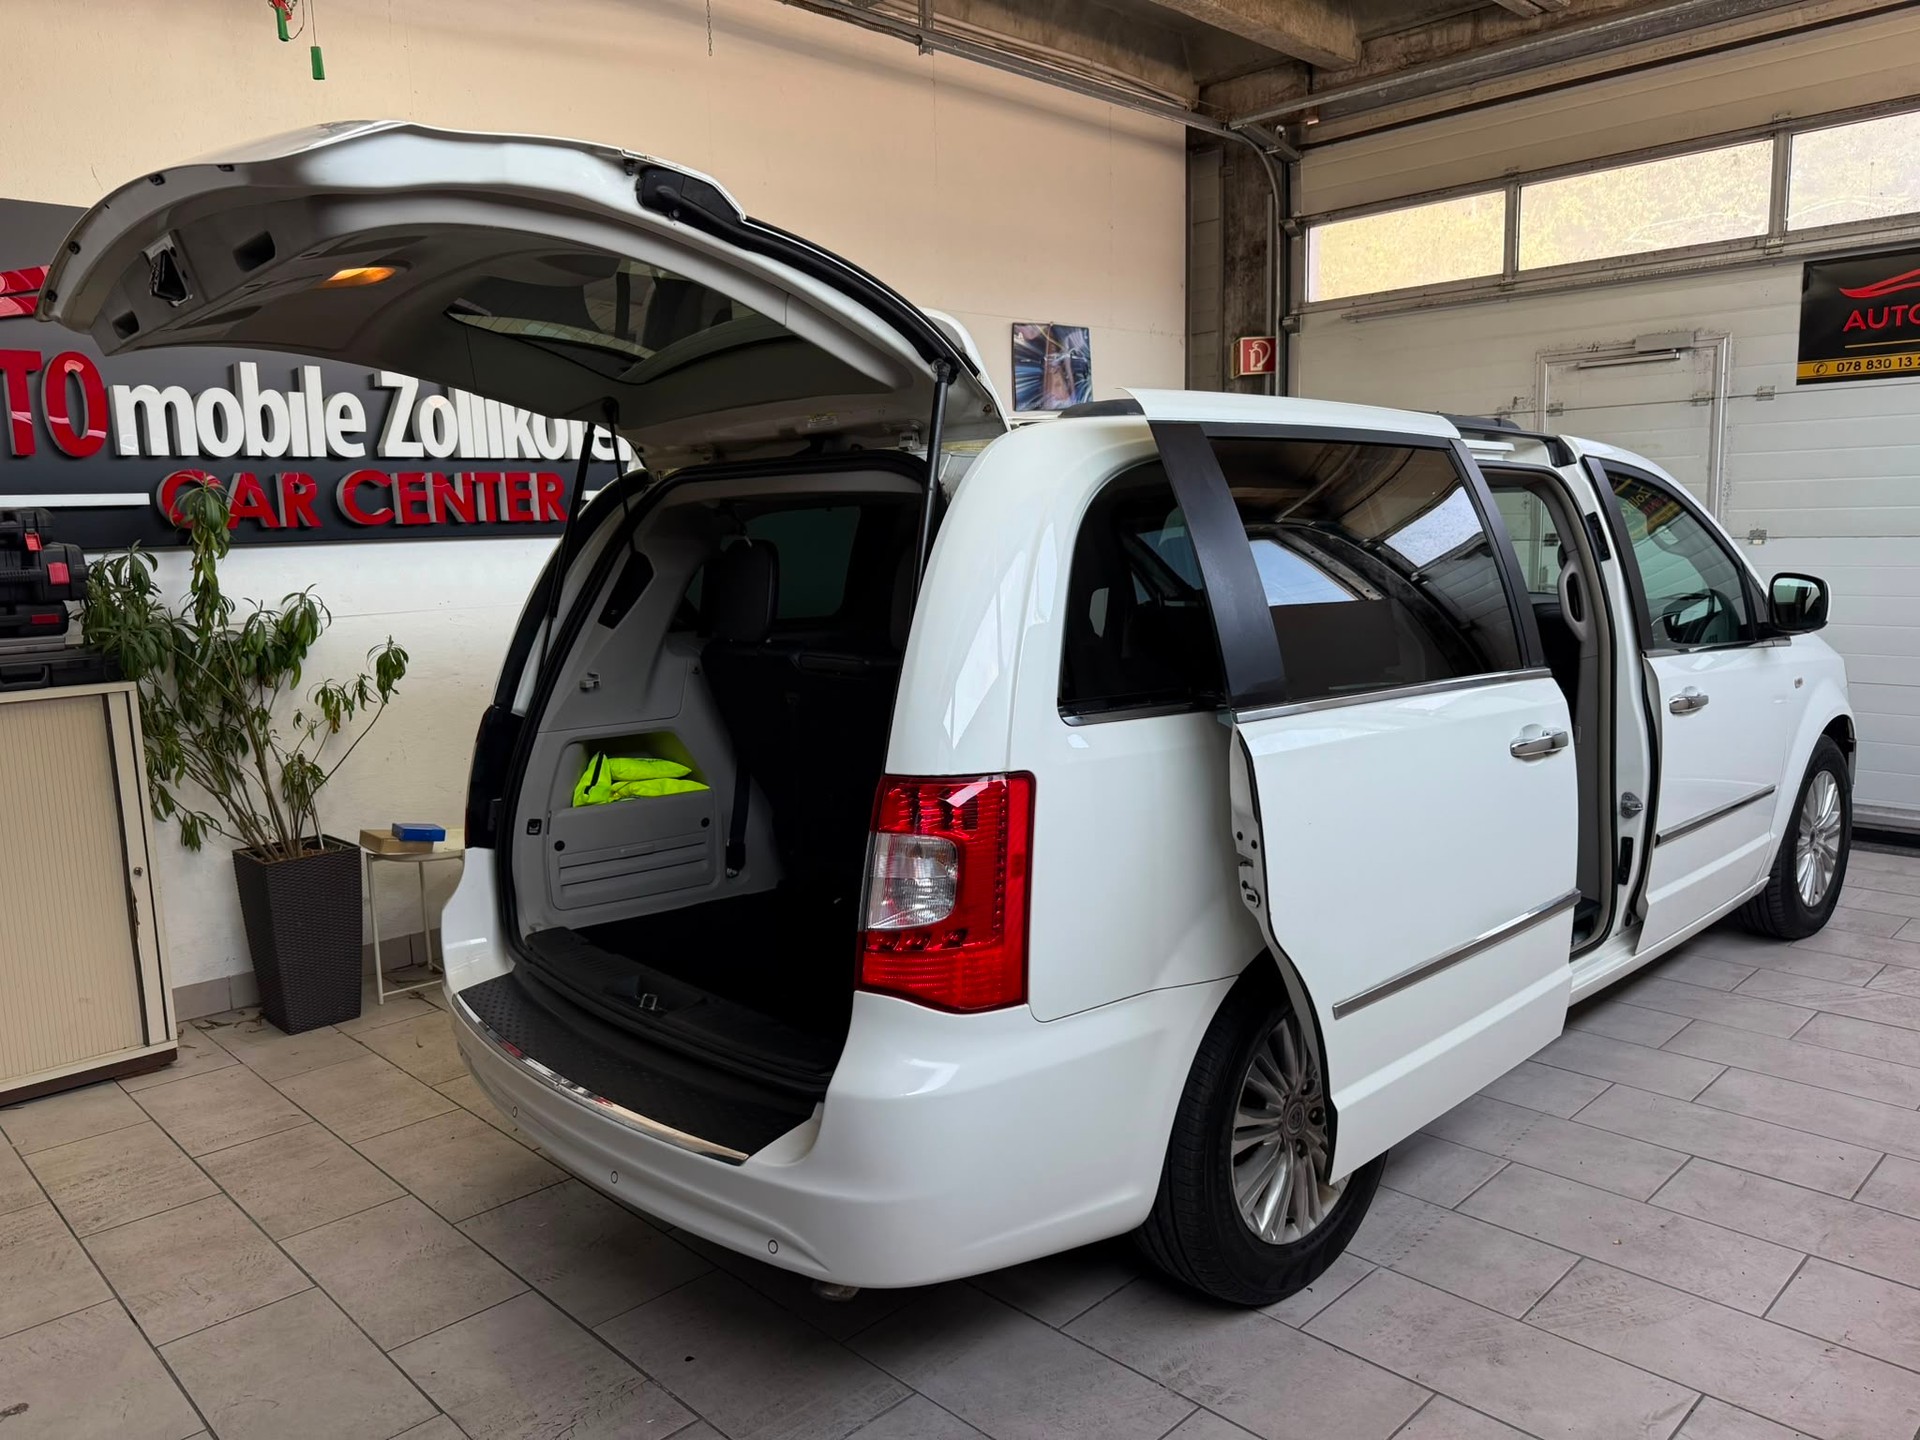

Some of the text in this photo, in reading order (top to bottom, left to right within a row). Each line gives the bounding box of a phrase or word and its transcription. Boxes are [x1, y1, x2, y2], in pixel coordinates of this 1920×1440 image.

[1836, 361, 1862, 373] 078
[1866, 358, 1892, 370] 830
[1898, 356, 1913, 367] 13
[156, 469, 568, 529] CAR CENTER
